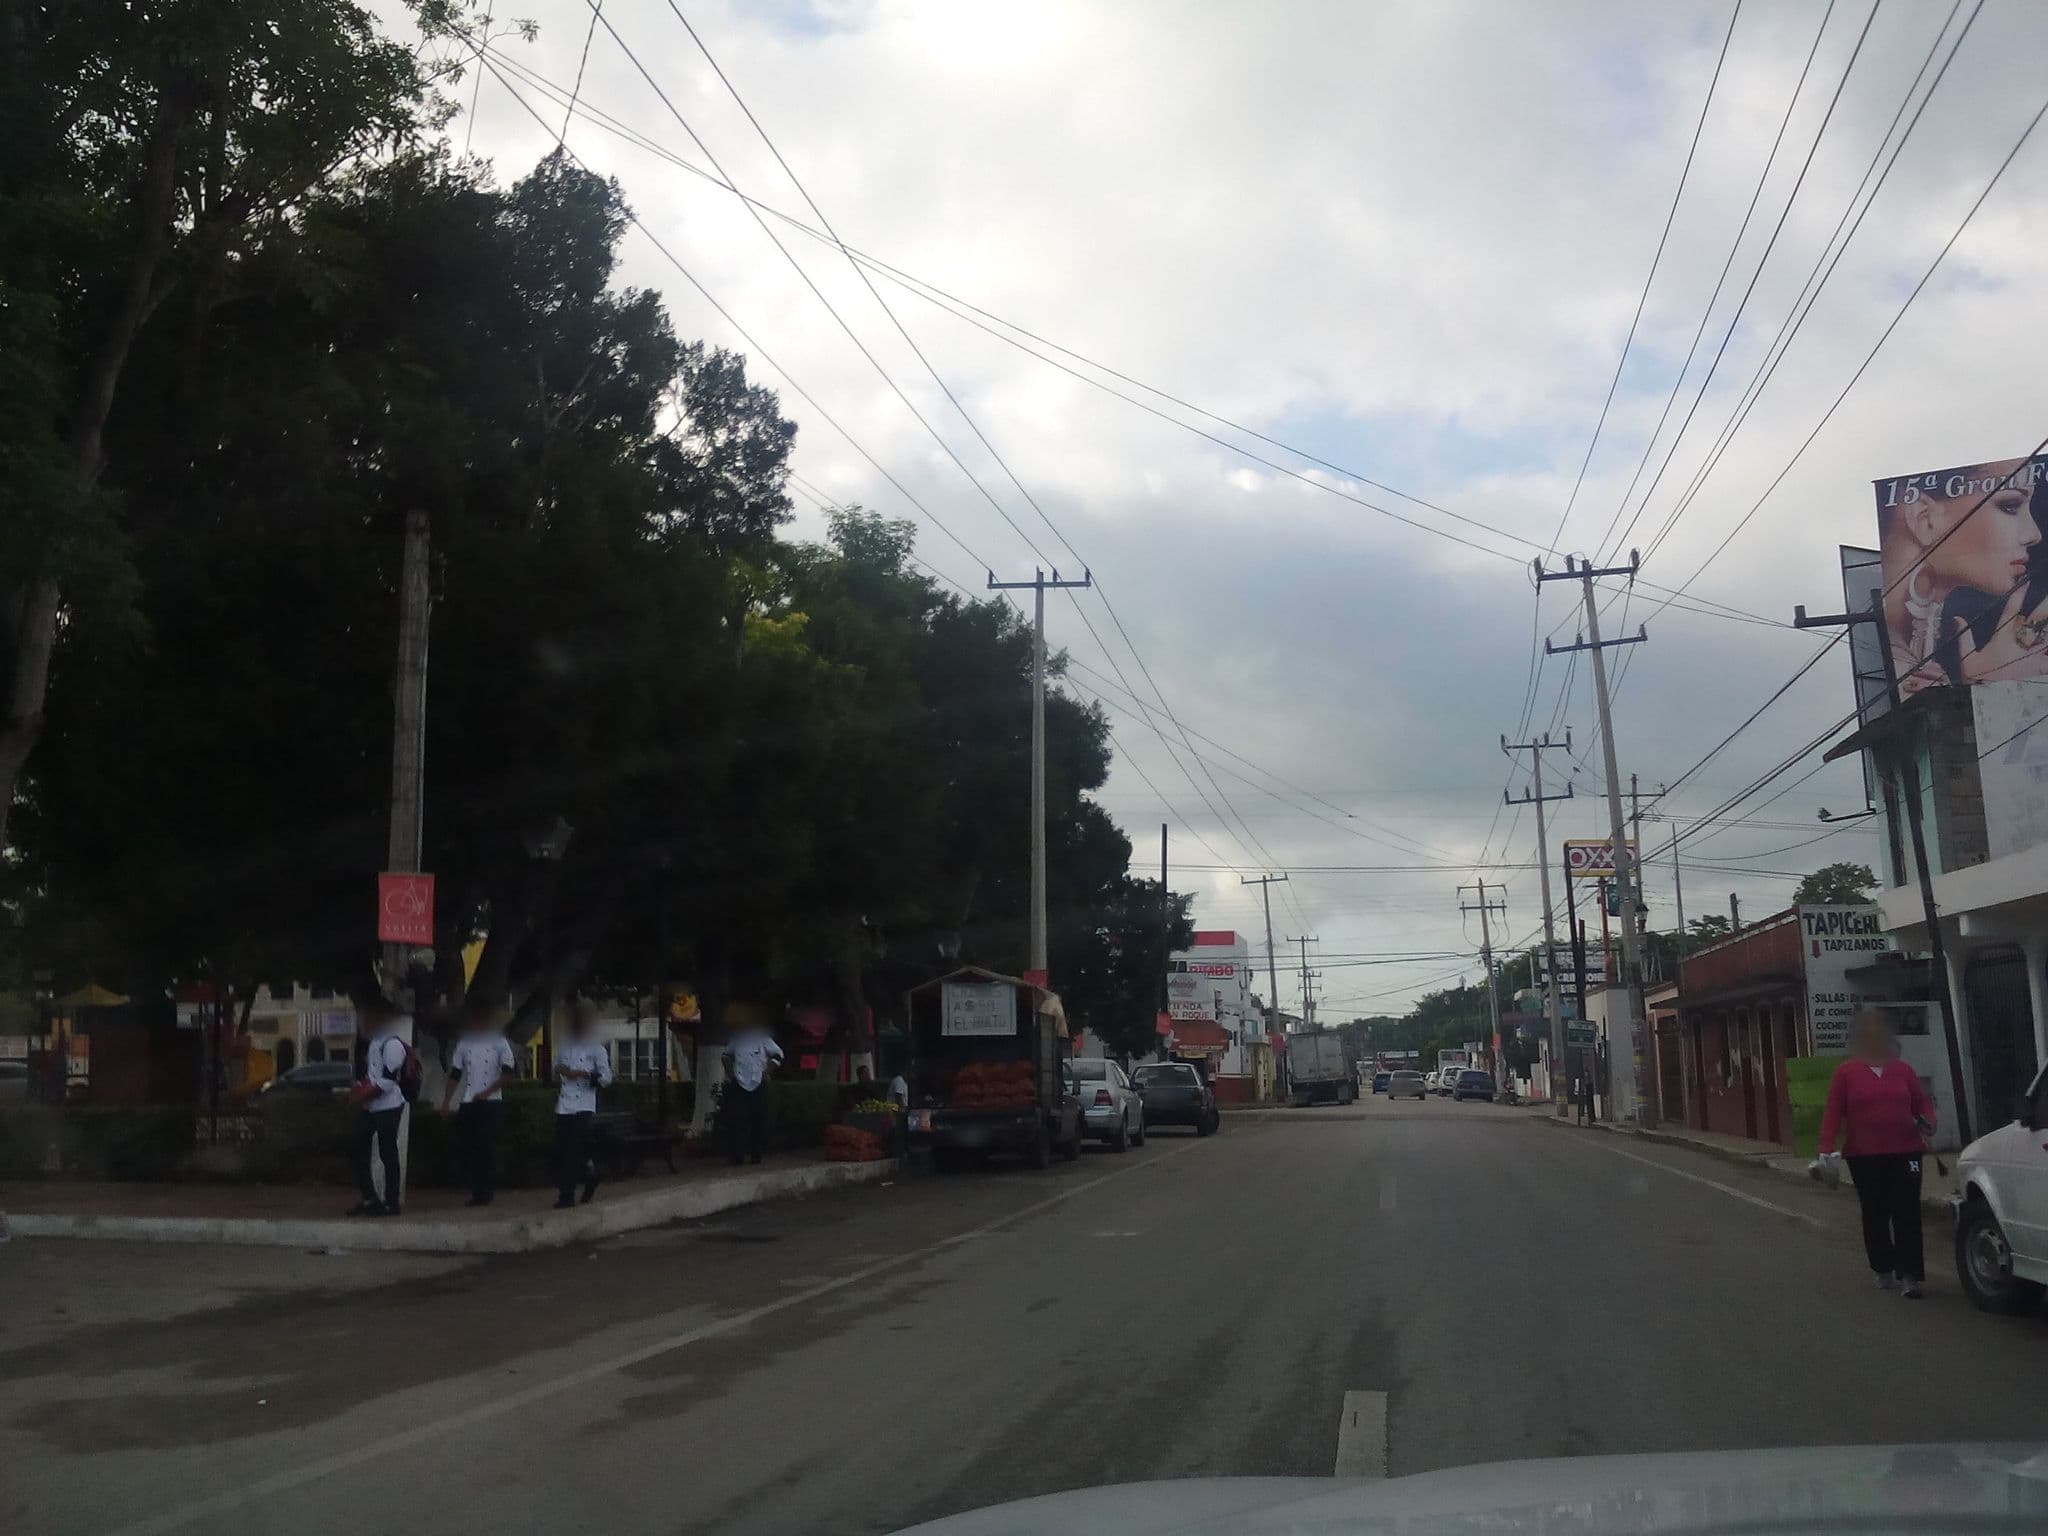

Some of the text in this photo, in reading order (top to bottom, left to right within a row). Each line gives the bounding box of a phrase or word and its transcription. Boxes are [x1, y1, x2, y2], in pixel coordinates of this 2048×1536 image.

[1884, 473, 1938, 507] 15ª
[1945, 472, 2017, 498] Gran
[1803, 911, 1882, 936] TAPICERI
[1824, 938, 1886, 951] TAPIZAMOS
